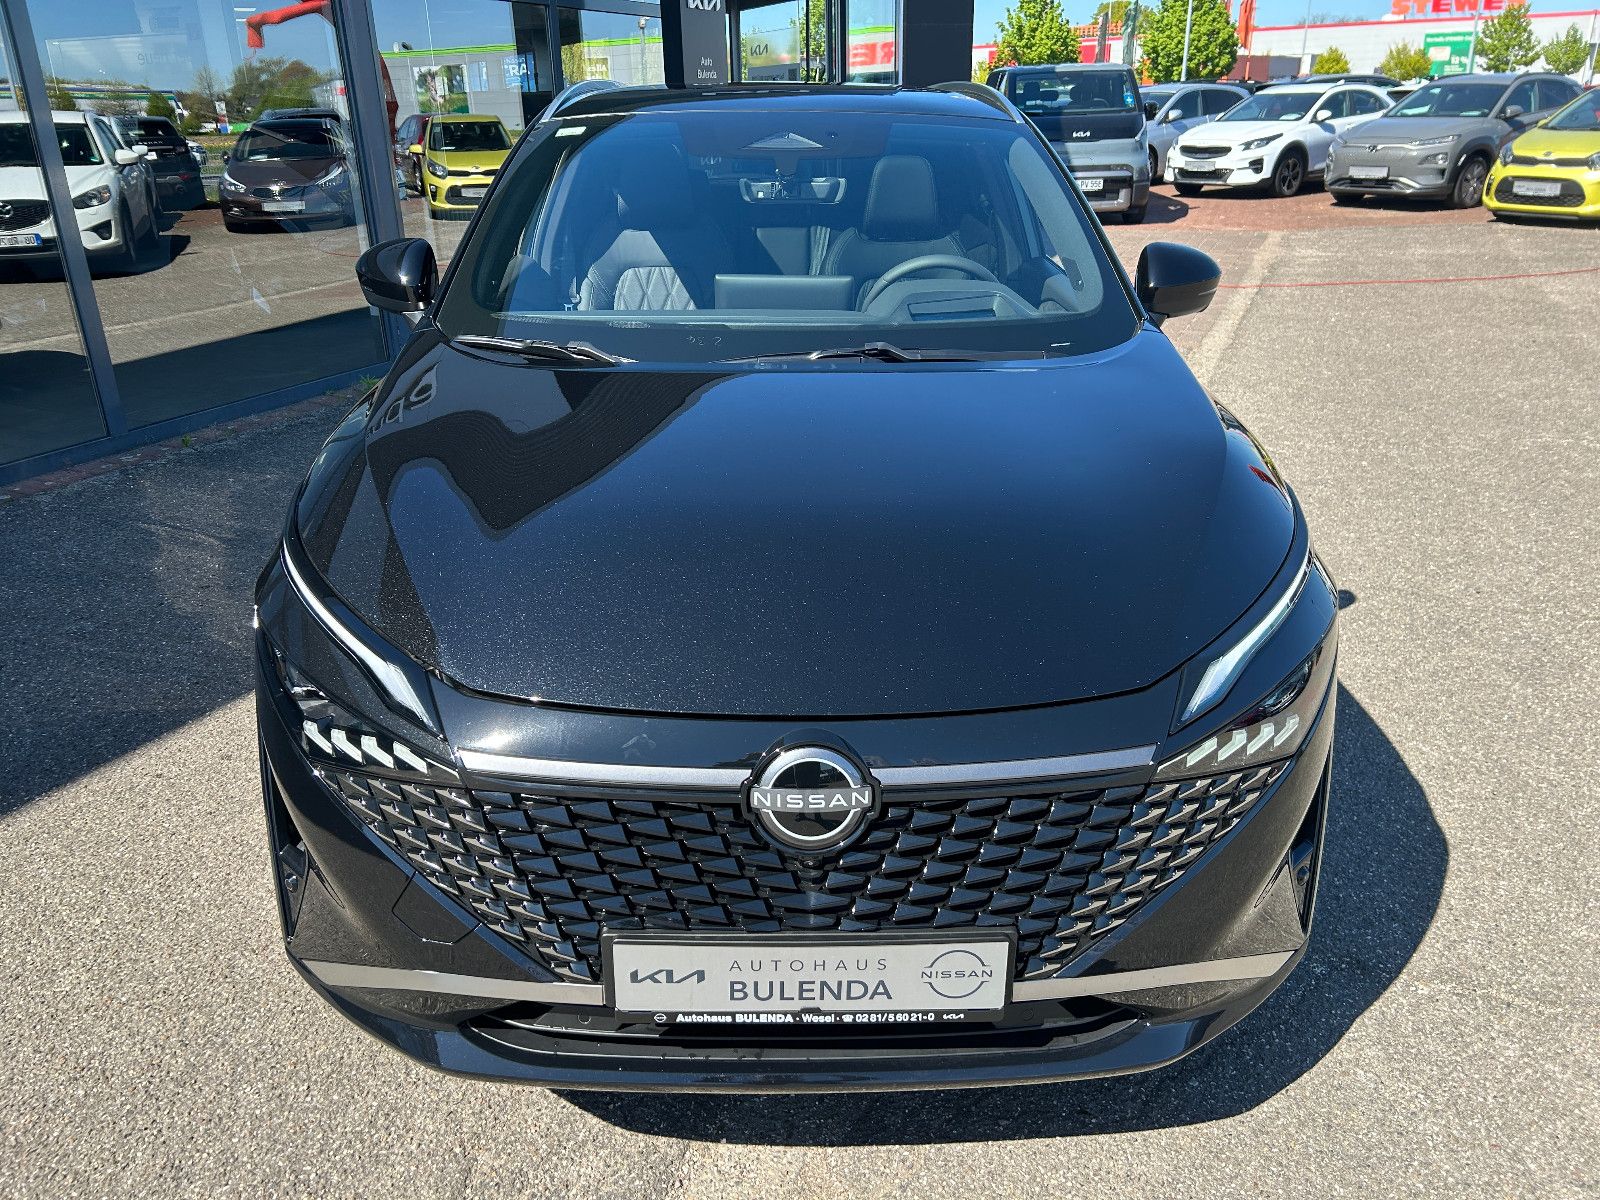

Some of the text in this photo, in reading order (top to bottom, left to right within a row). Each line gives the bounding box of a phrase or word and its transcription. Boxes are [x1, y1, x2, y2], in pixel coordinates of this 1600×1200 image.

[700, 56, 713, 67] Auto
[752, 790, 870, 809] NISSAN
[729, 958, 888, 972] AUTOHAUS
[629, 968, 706, 985] KIA
[920, 969, 993, 980] NISSAN
[729, 980, 893, 1001] BULENDA
[676, 1013, 733, 1023] Autohaus
[735, 1013, 794, 1023] BULENDA
[801, 1013, 835, 1023] Wesel
